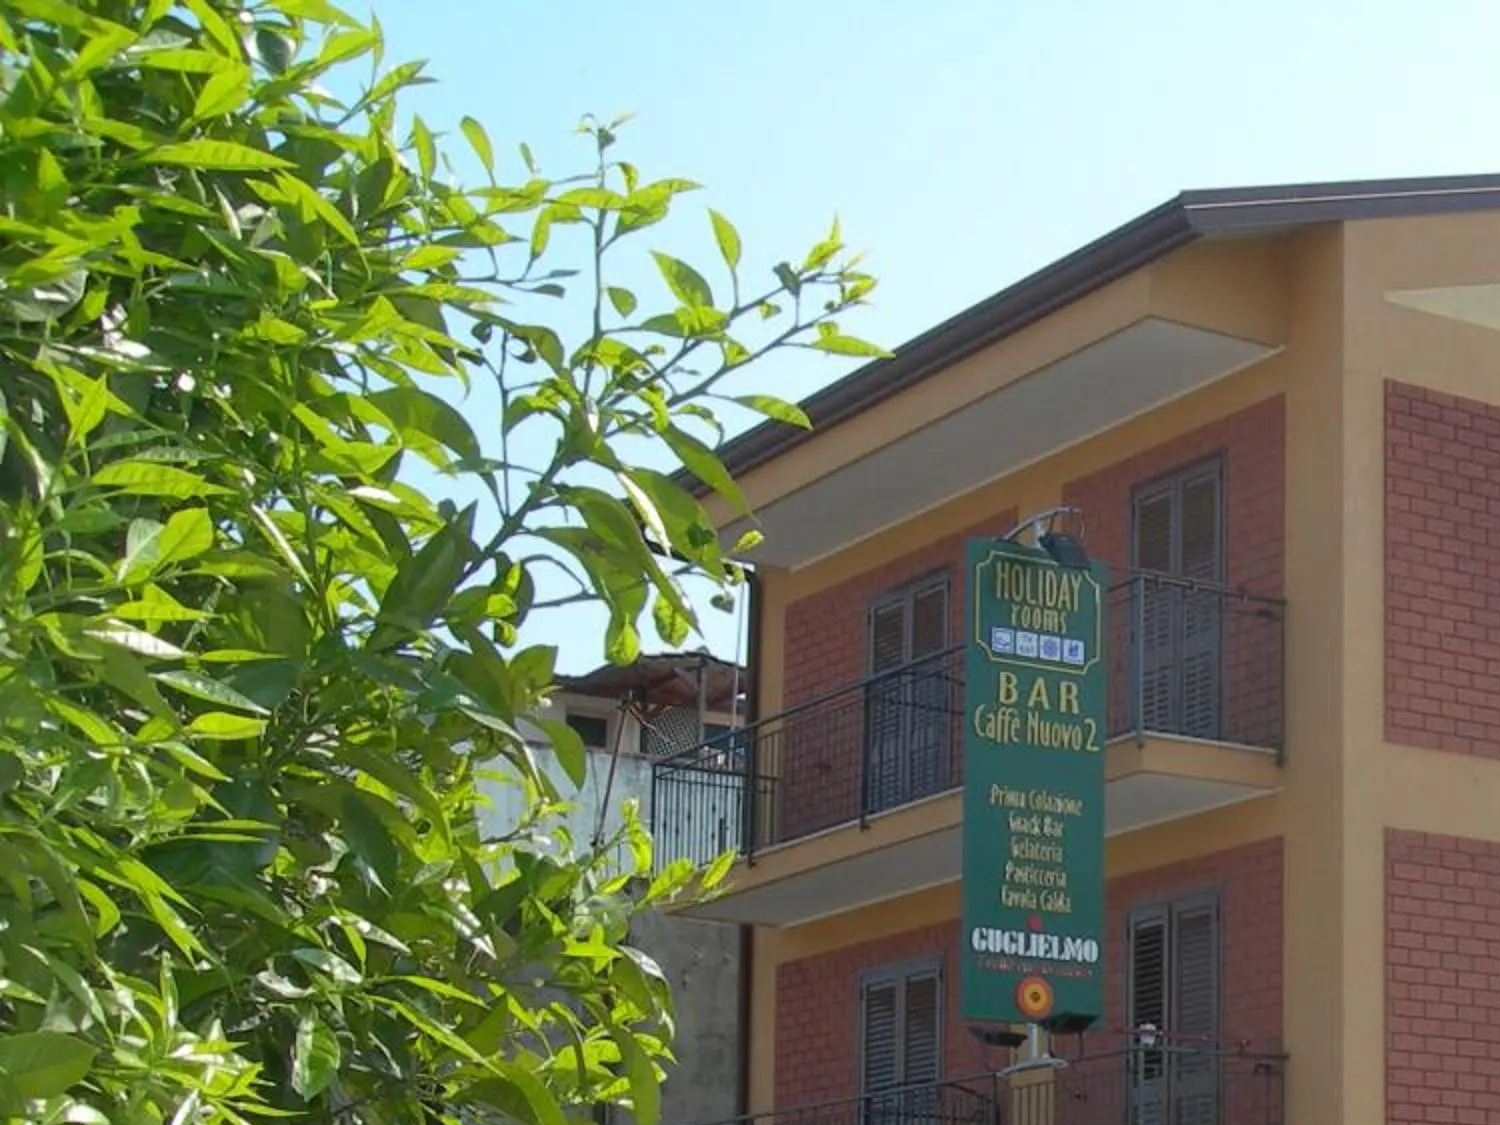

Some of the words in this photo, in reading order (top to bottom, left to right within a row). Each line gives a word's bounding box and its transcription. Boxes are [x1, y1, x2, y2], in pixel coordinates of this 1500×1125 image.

[996, 561, 1082, 612] HOLIDAY
[1012, 604, 1067, 635] rooms
[1000, 672, 1080, 714] BAR
[1027, 712, 1082, 750] Nuovo
[1083, 718, 1099, 751] 2
[971, 927, 1099, 964] GUGLIELMO
